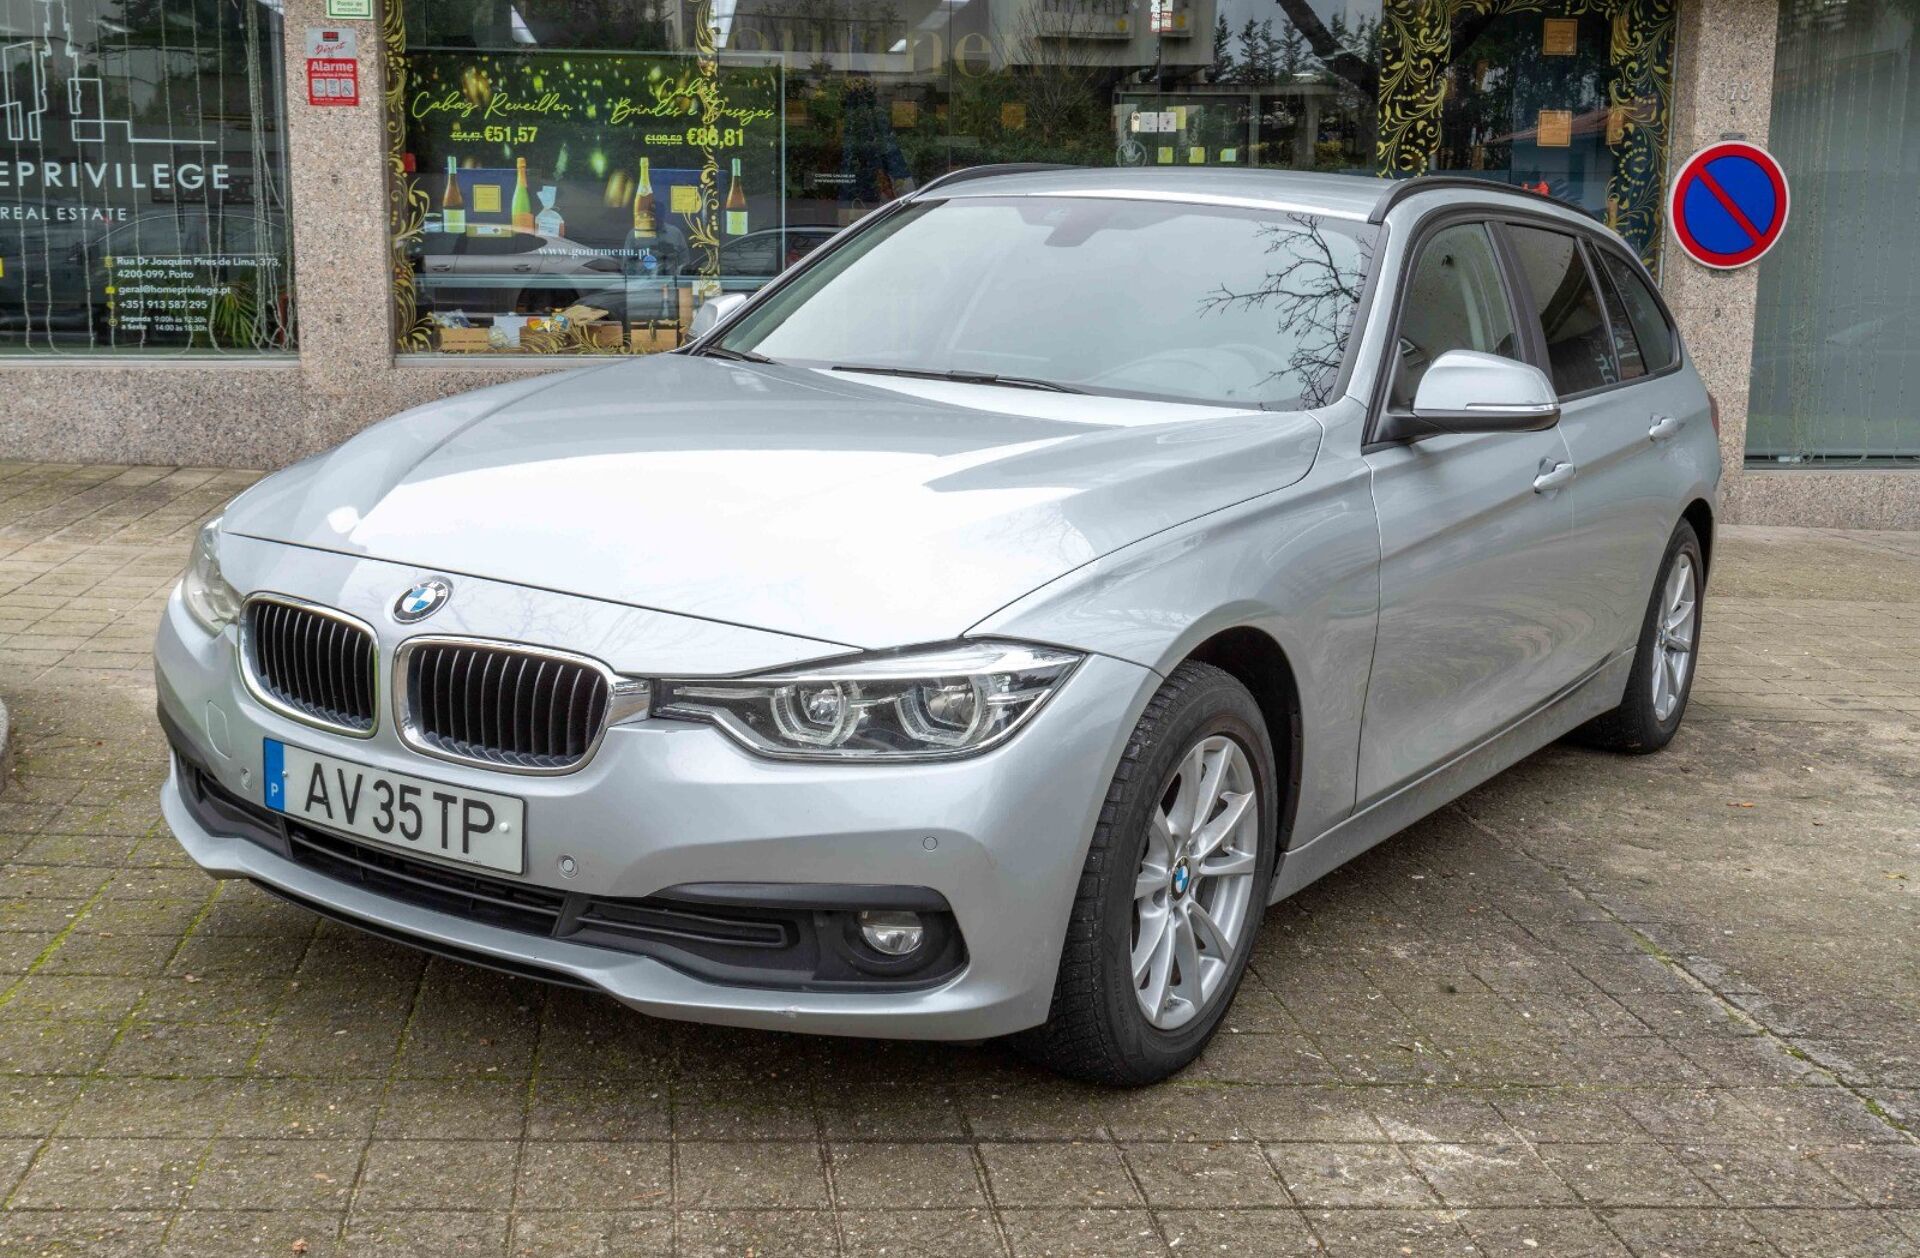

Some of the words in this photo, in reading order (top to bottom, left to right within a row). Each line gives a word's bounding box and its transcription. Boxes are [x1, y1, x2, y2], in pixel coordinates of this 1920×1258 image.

[311, 61, 354, 72] Alarme
[412, 91, 479, 119] Cabaz
[484, 92, 574, 120] Reveillon
[611, 97, 682, 124] Brindes
[484, 126, 538, 144] €51,57
[686, 127, 744, 148] €86,81
[0, 206, 50, 220] REAL
[56, 207, 127, 221] ESTATE
[538, 247, 650, 260] www.gourmenu.pt
[117, 257, 135, 266] Rua
[138, 257, 149, 266] Dr
[151, 257, 192, 268] Joaquim
[194, 257, 217, 266] Pires
[219, 257, 231, 266] de
[117, 270, 168, 280] 4200-099,
[169, 270, 194, 279] Porto
[119, 285, 231, 296] geral@homeprivilege.pt
[120, 300, 144, 309] +351
[147, 300, 166, 309] 913
[168, 300, 187, 309] 587
[189, 300, 208, 309] 295
[270, 781, 279, 797] P
